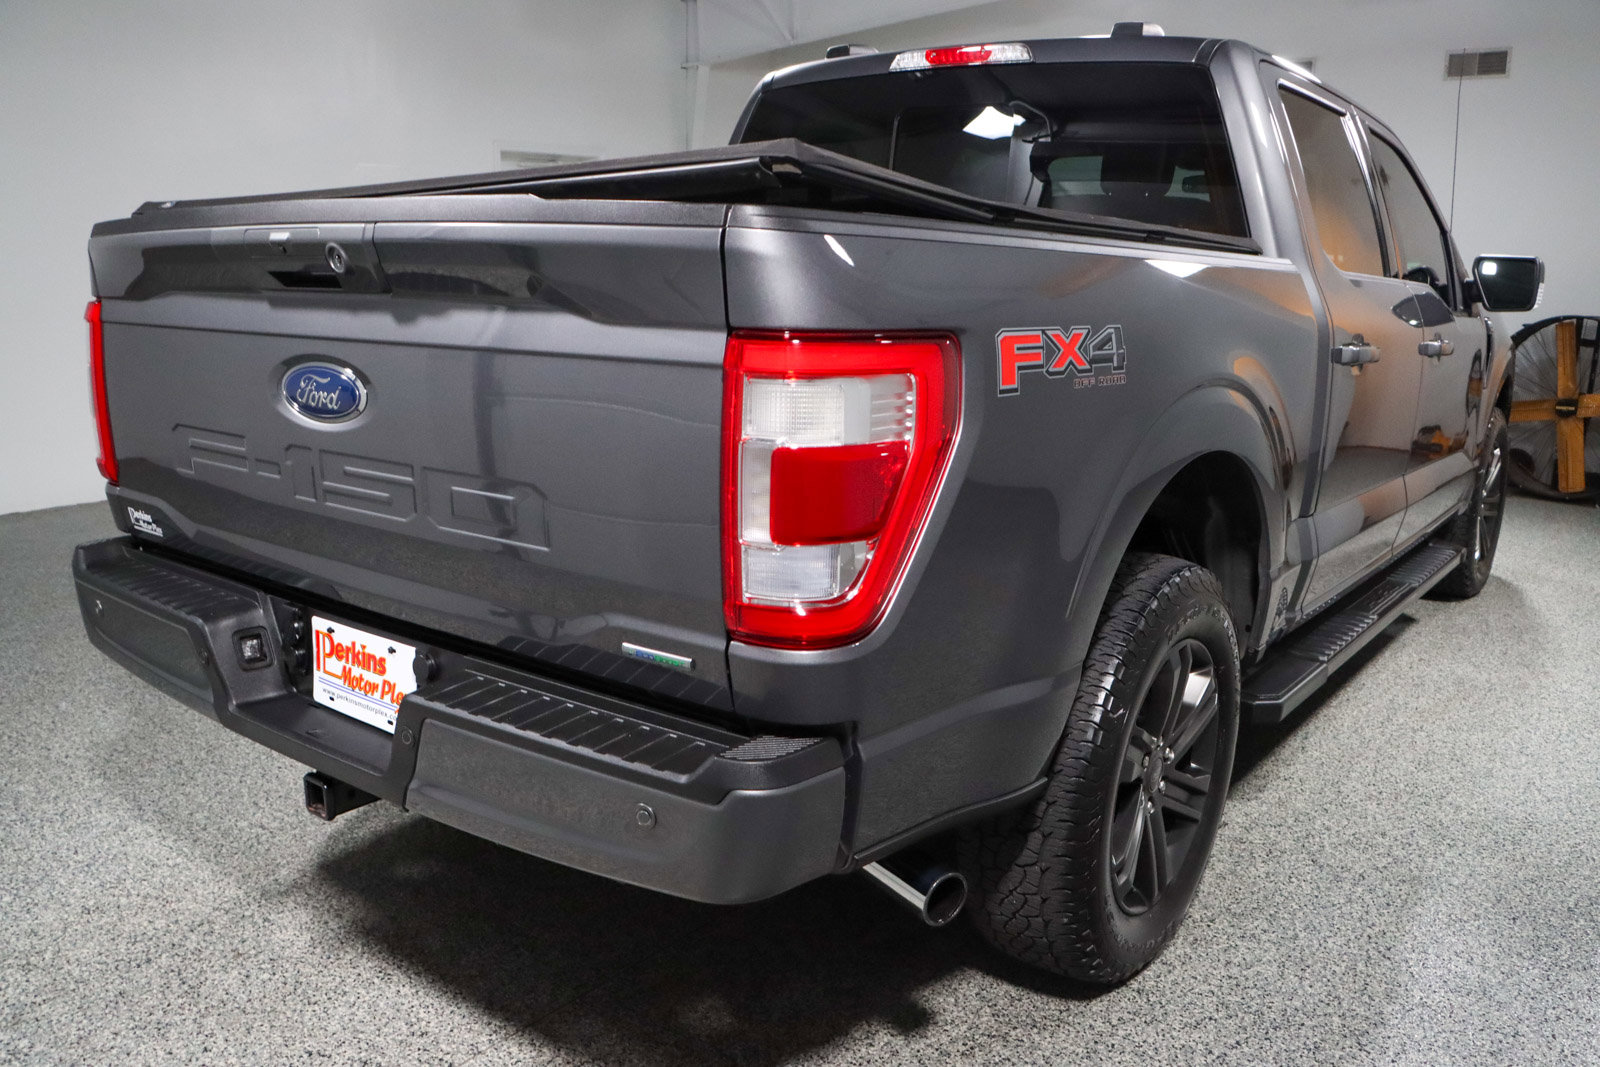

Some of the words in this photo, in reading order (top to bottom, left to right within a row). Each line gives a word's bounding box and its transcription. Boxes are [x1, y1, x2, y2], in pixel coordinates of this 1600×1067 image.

[995, 324, 1127, 397] FX4
[296, 373, 342, 410] Ford
[173, 423, 551, 552] F-150
[315, 629, 387, 676] Perkins
[322, 687, 397, 720] www.perkinsmotorplex.co
[341, 665, 379, 697] Motor
[380, 679, 407, 713] Ple
